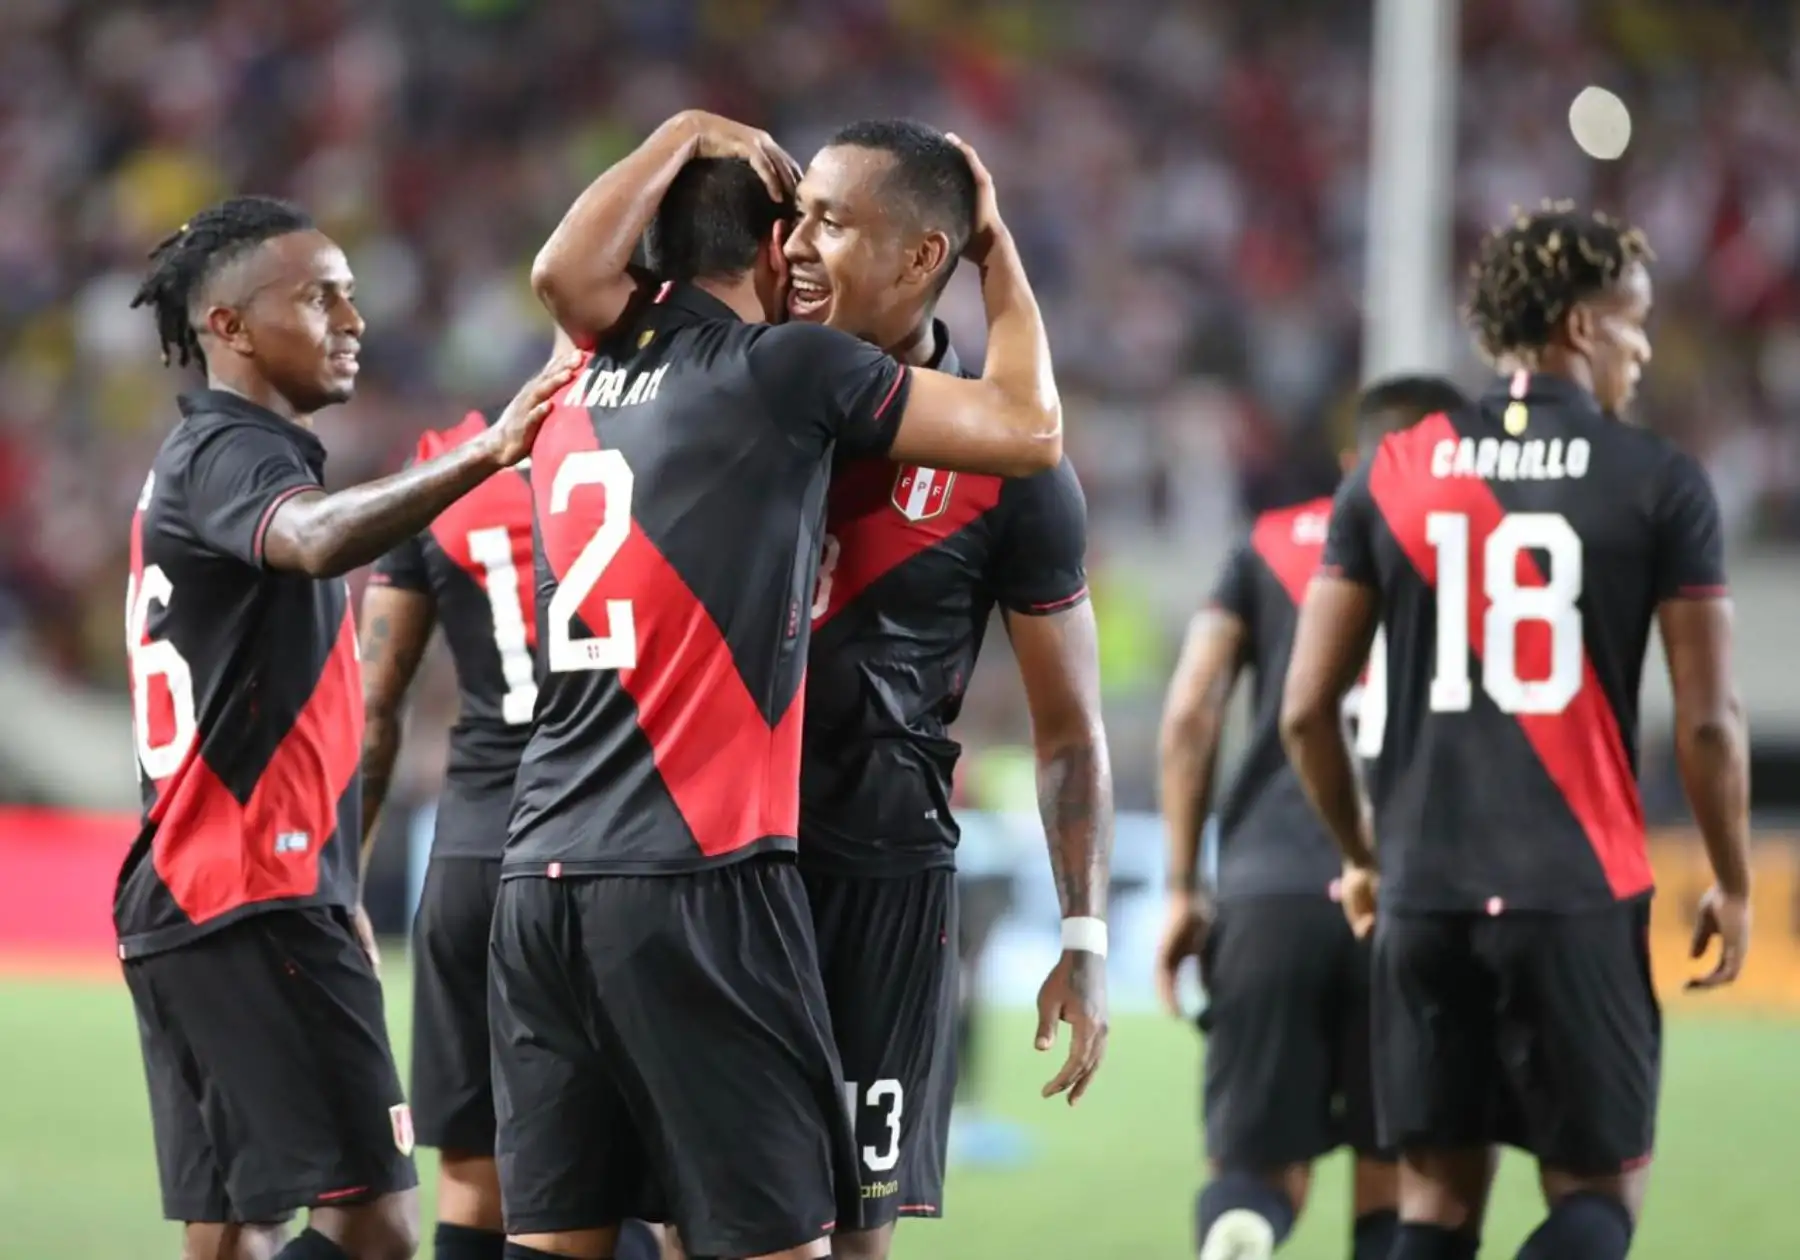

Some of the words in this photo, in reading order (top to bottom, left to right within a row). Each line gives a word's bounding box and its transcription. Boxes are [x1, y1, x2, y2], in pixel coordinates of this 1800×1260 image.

[1431, 436, 1590, 480] CARRILLO
[548, 449, 637, 671] 2
[1426, 512, 1582, 714] 18
